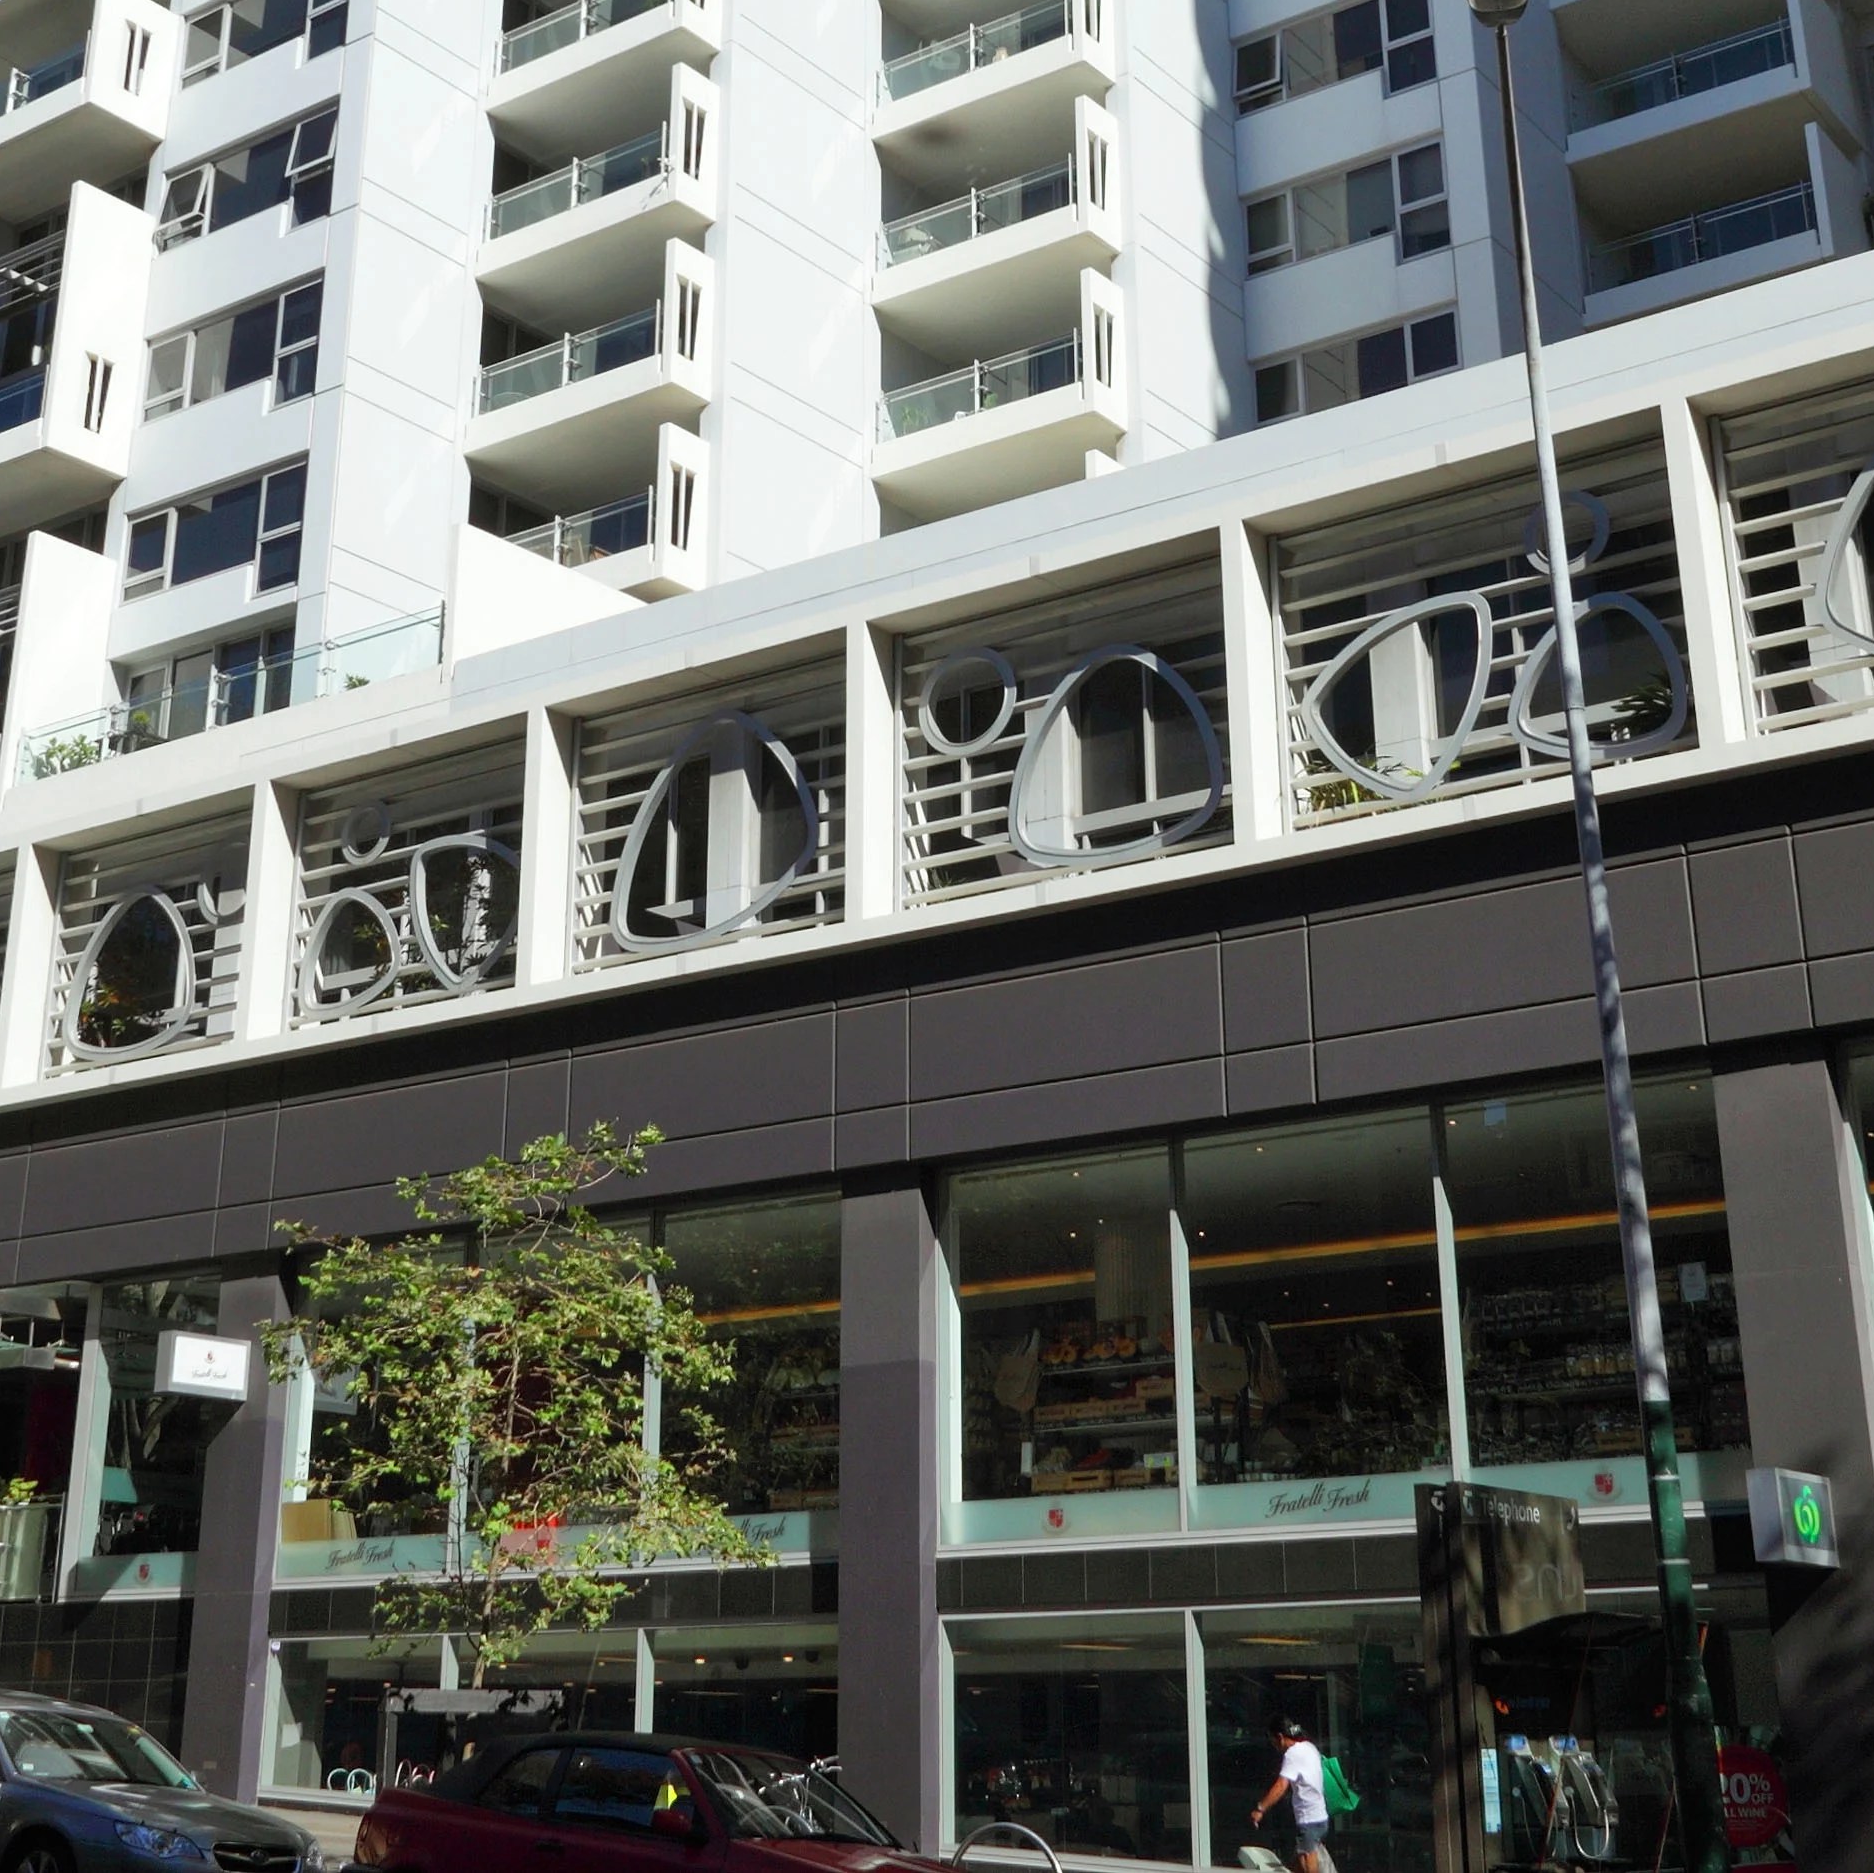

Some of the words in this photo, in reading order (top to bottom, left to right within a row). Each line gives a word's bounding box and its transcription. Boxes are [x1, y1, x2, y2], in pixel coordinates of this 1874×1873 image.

[1265, 1481, 1325, 1518] Fratelli
[1322, 1478, 1371, 1512] Fresh
[1481, 1493, 1541, 1525] Telephone
[750, 1516, 786, 1542] Fresh
[325, 1540, 366, 1570] Fratelli
[363, 1538, 396, 1566] Fresh
[1751, 1793, 1775, 1805] OFF
